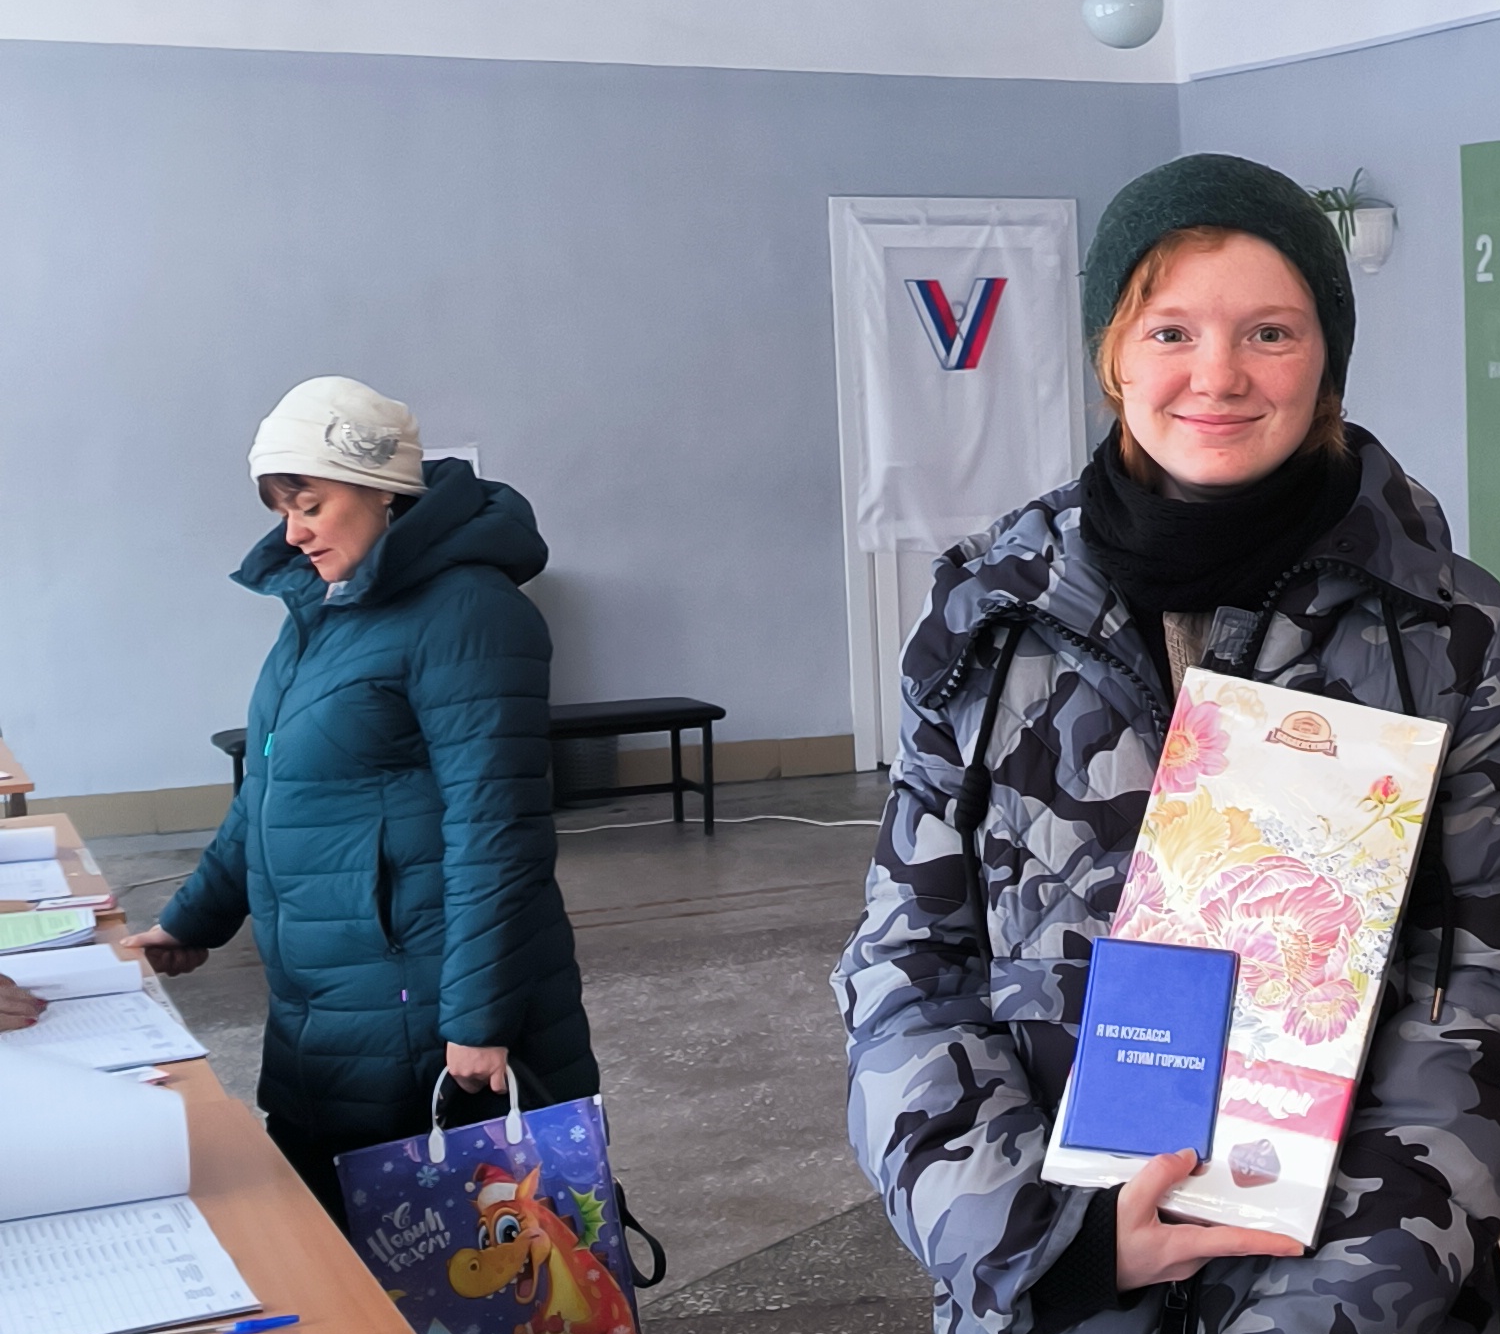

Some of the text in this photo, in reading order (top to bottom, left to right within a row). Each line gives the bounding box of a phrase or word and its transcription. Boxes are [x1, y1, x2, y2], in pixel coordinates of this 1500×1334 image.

[1096, 1023, 1171, 1043] Я ИЗ КУZБАССА
[1117, 1049, 1206, 1070] И ЭТИМ ГОРЖУСЬ!
